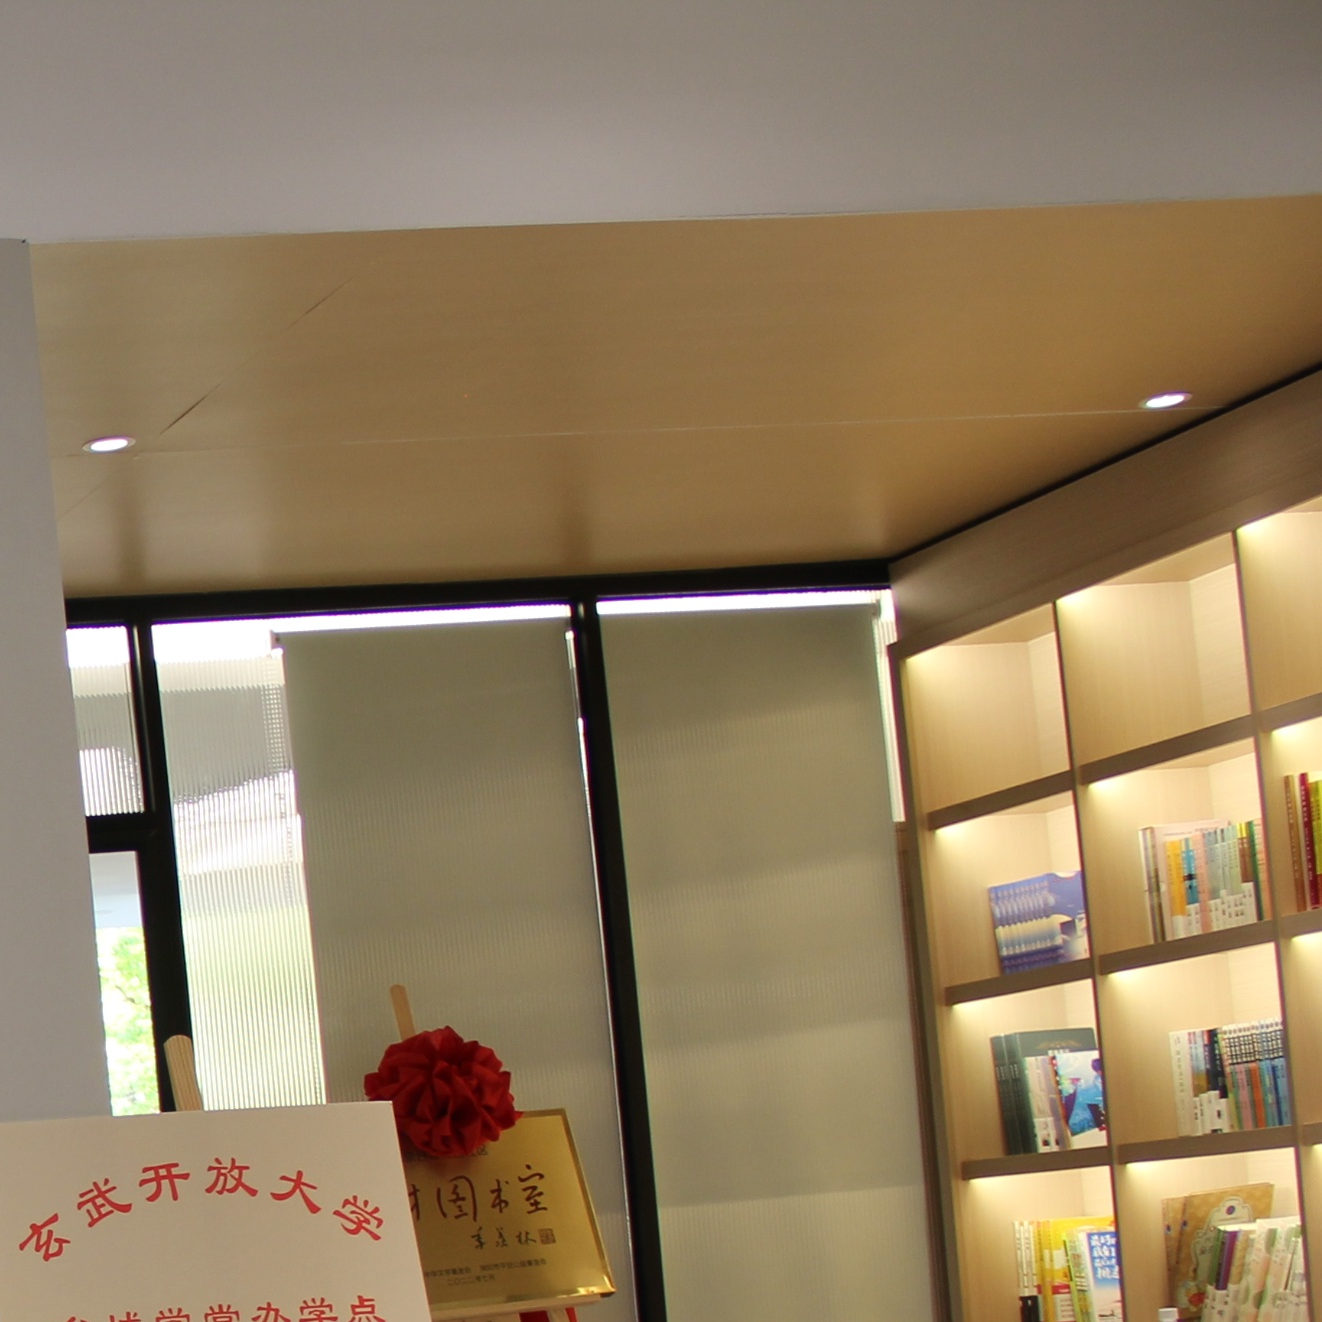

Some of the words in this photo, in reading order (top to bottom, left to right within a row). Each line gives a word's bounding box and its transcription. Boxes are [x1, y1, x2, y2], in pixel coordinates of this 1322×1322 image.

[19, 1158, 384, 1261] 玄武开放大学
